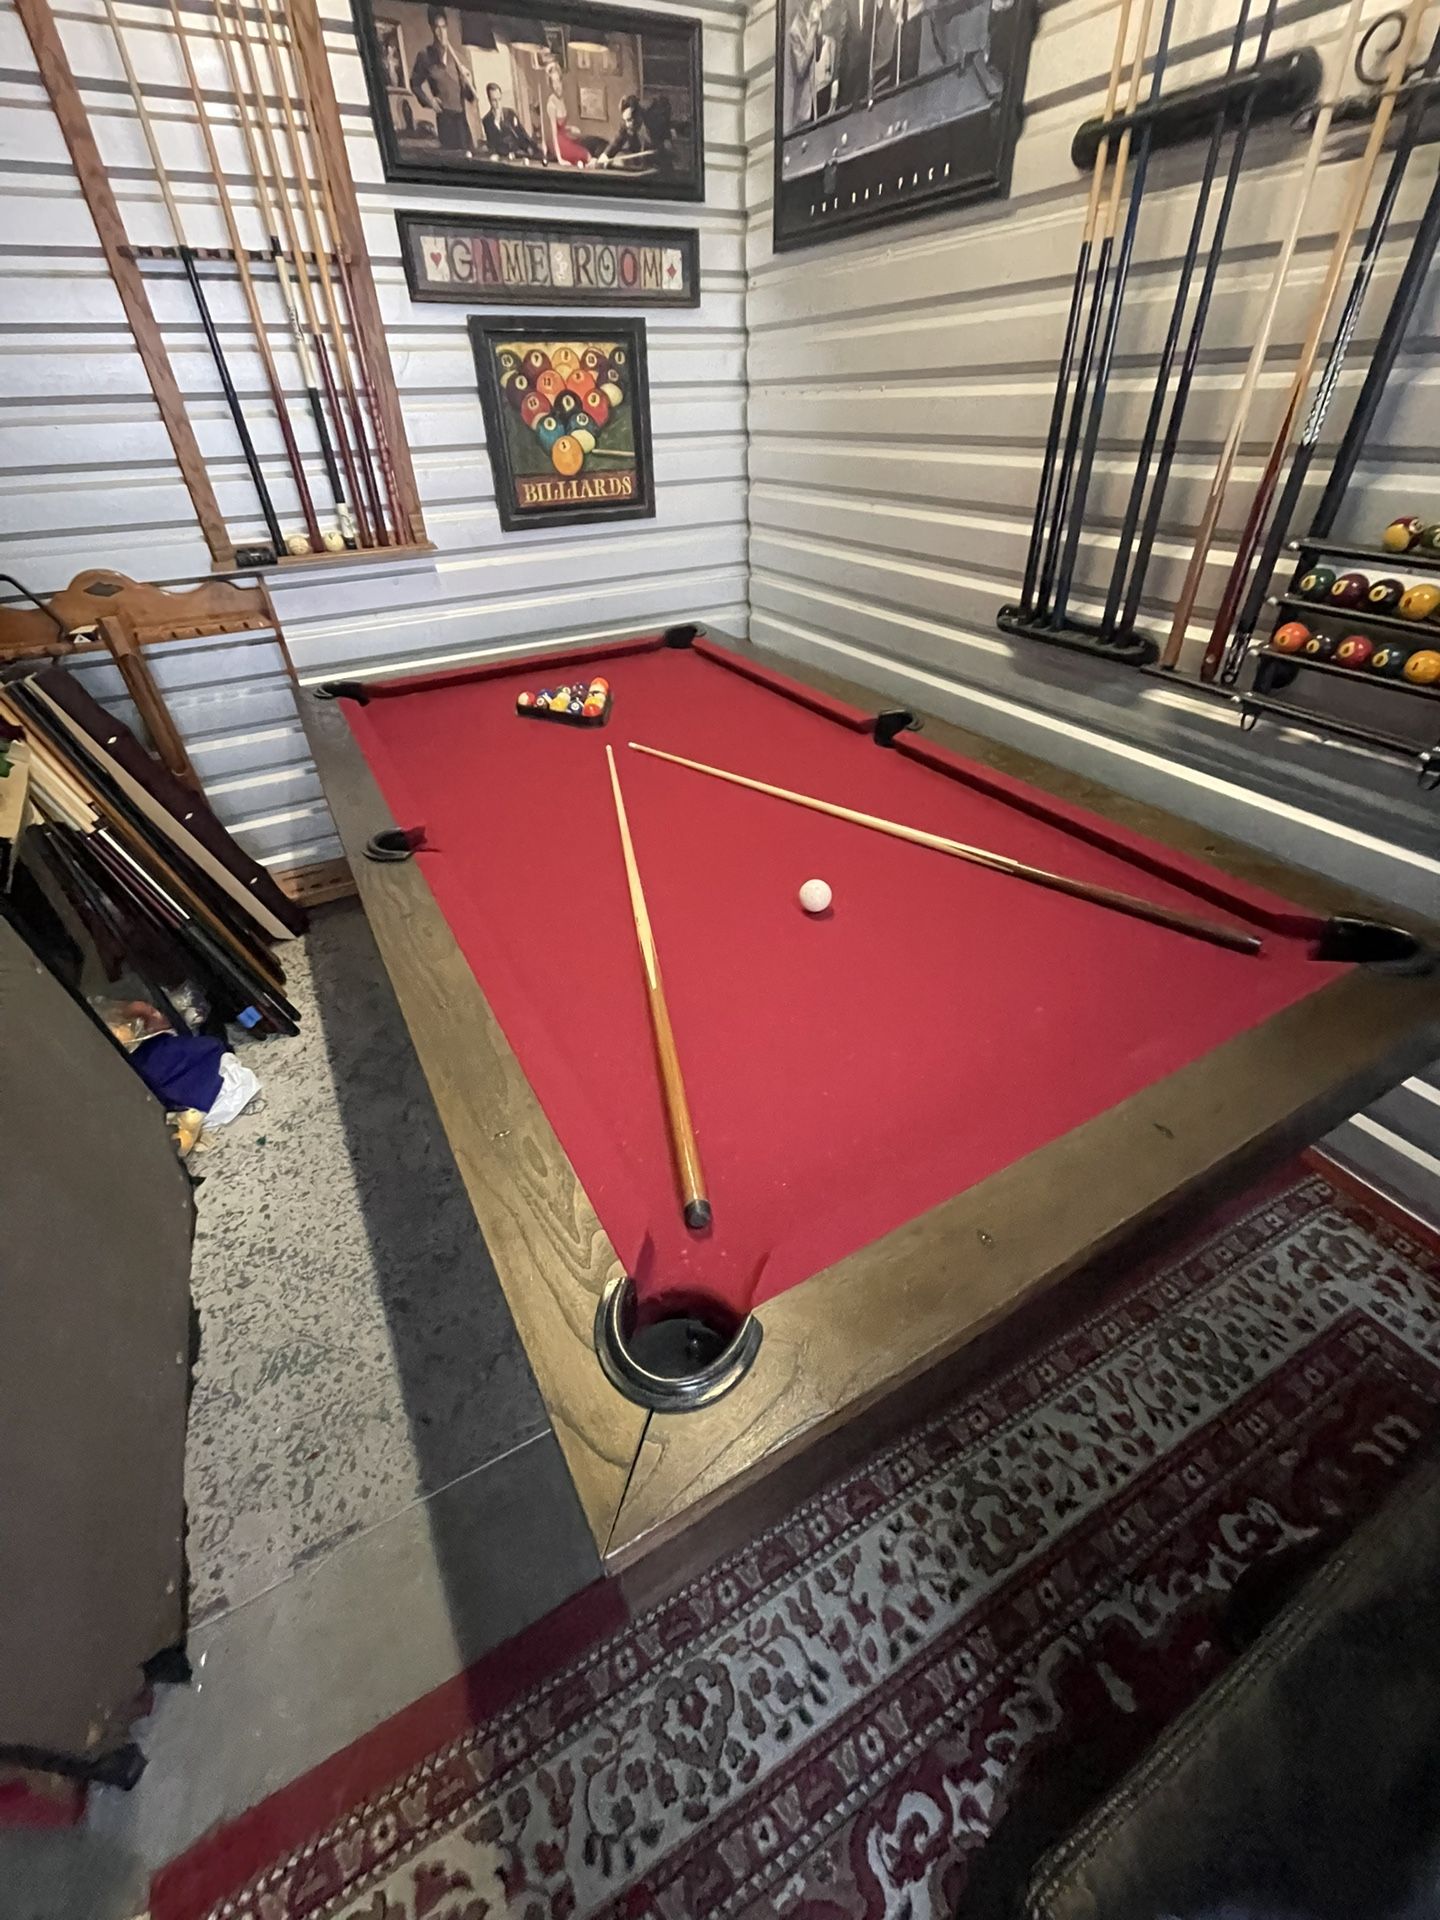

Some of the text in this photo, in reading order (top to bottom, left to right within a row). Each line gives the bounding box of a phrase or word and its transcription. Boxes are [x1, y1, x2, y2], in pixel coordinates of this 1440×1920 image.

[451, 239, 662, 288] GAME ROOM
[522, 476, 632, 503] BILLIARDS
